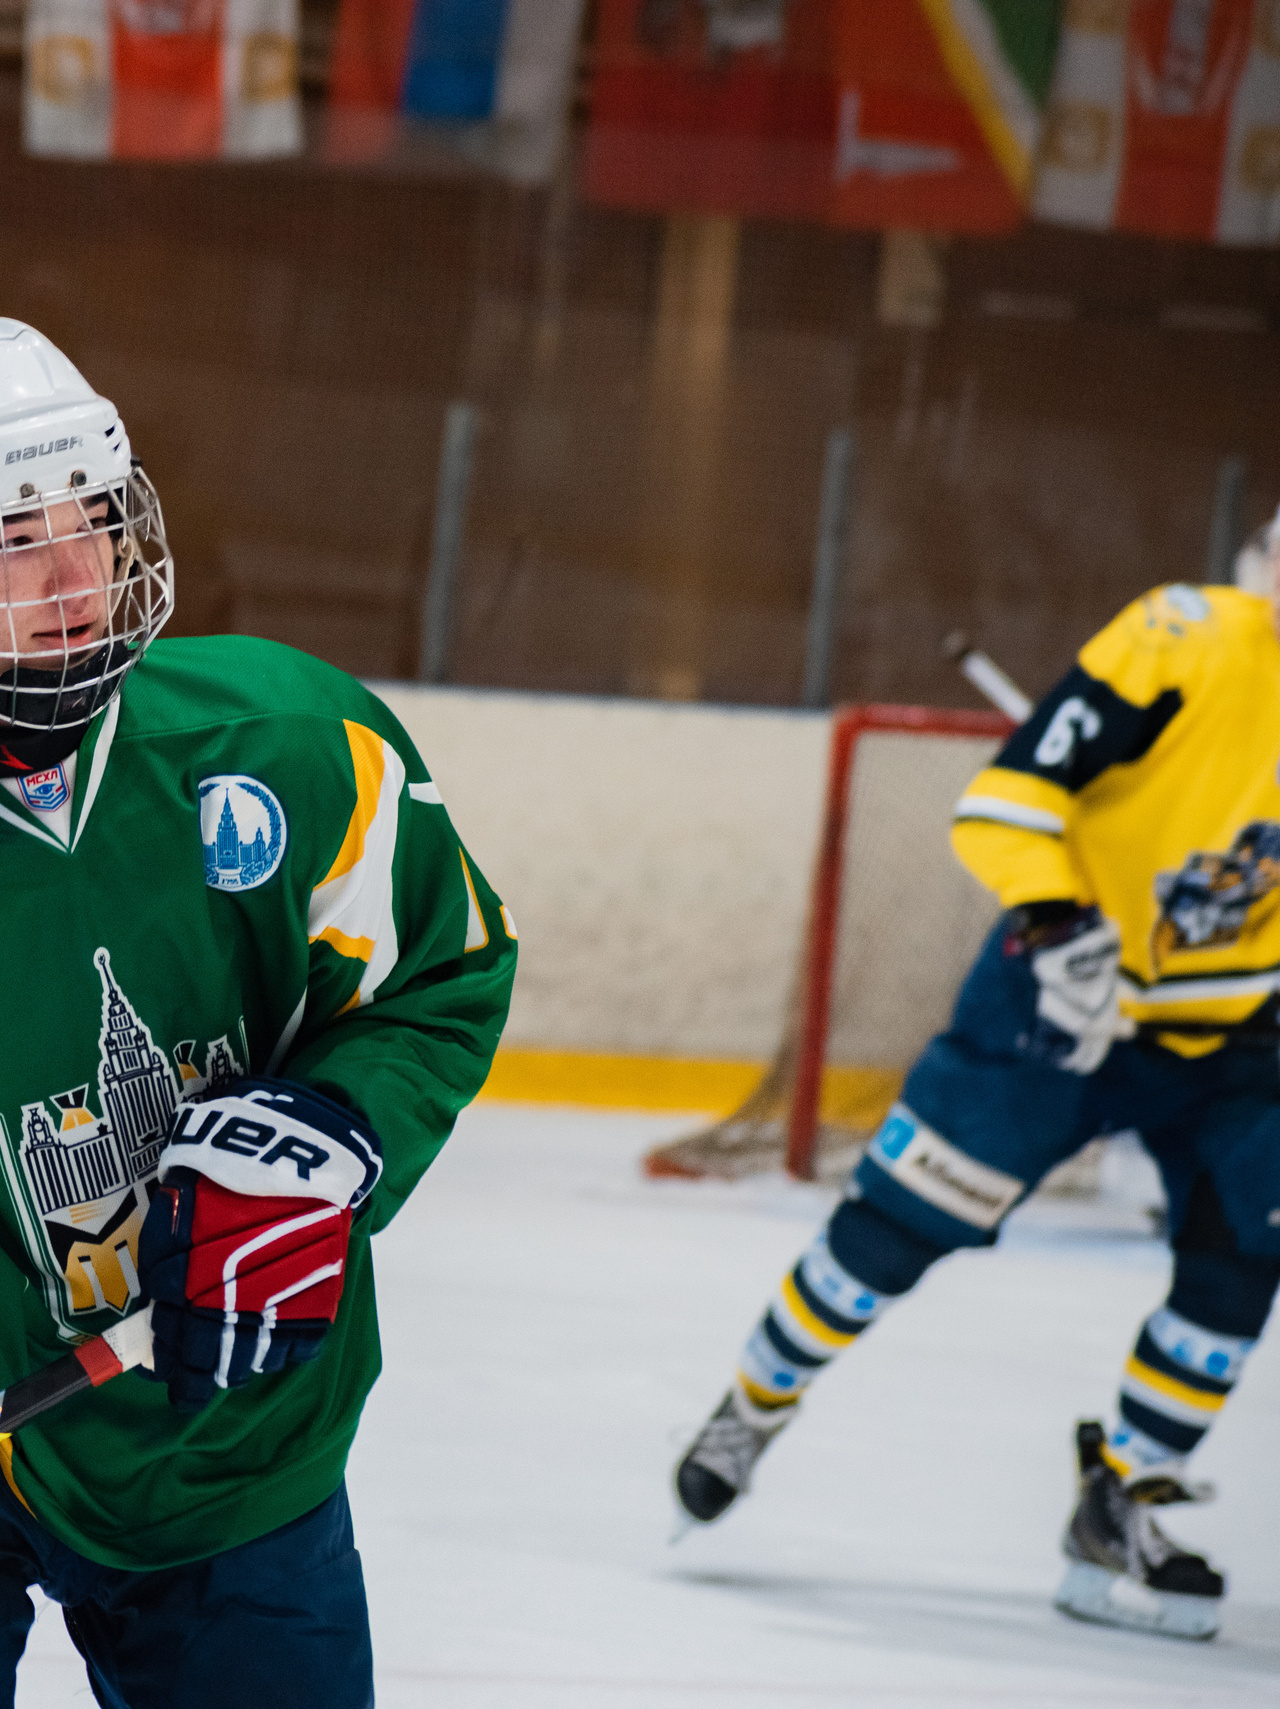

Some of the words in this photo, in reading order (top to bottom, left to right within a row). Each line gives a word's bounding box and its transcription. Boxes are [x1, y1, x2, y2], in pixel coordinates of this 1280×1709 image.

[4, 435, 83, 466] BAUER
[1034, 695, 1101, 767] 6
[25, 769, 59, 787] МСХЛ
[165, 1106, 330, 1182] UER
